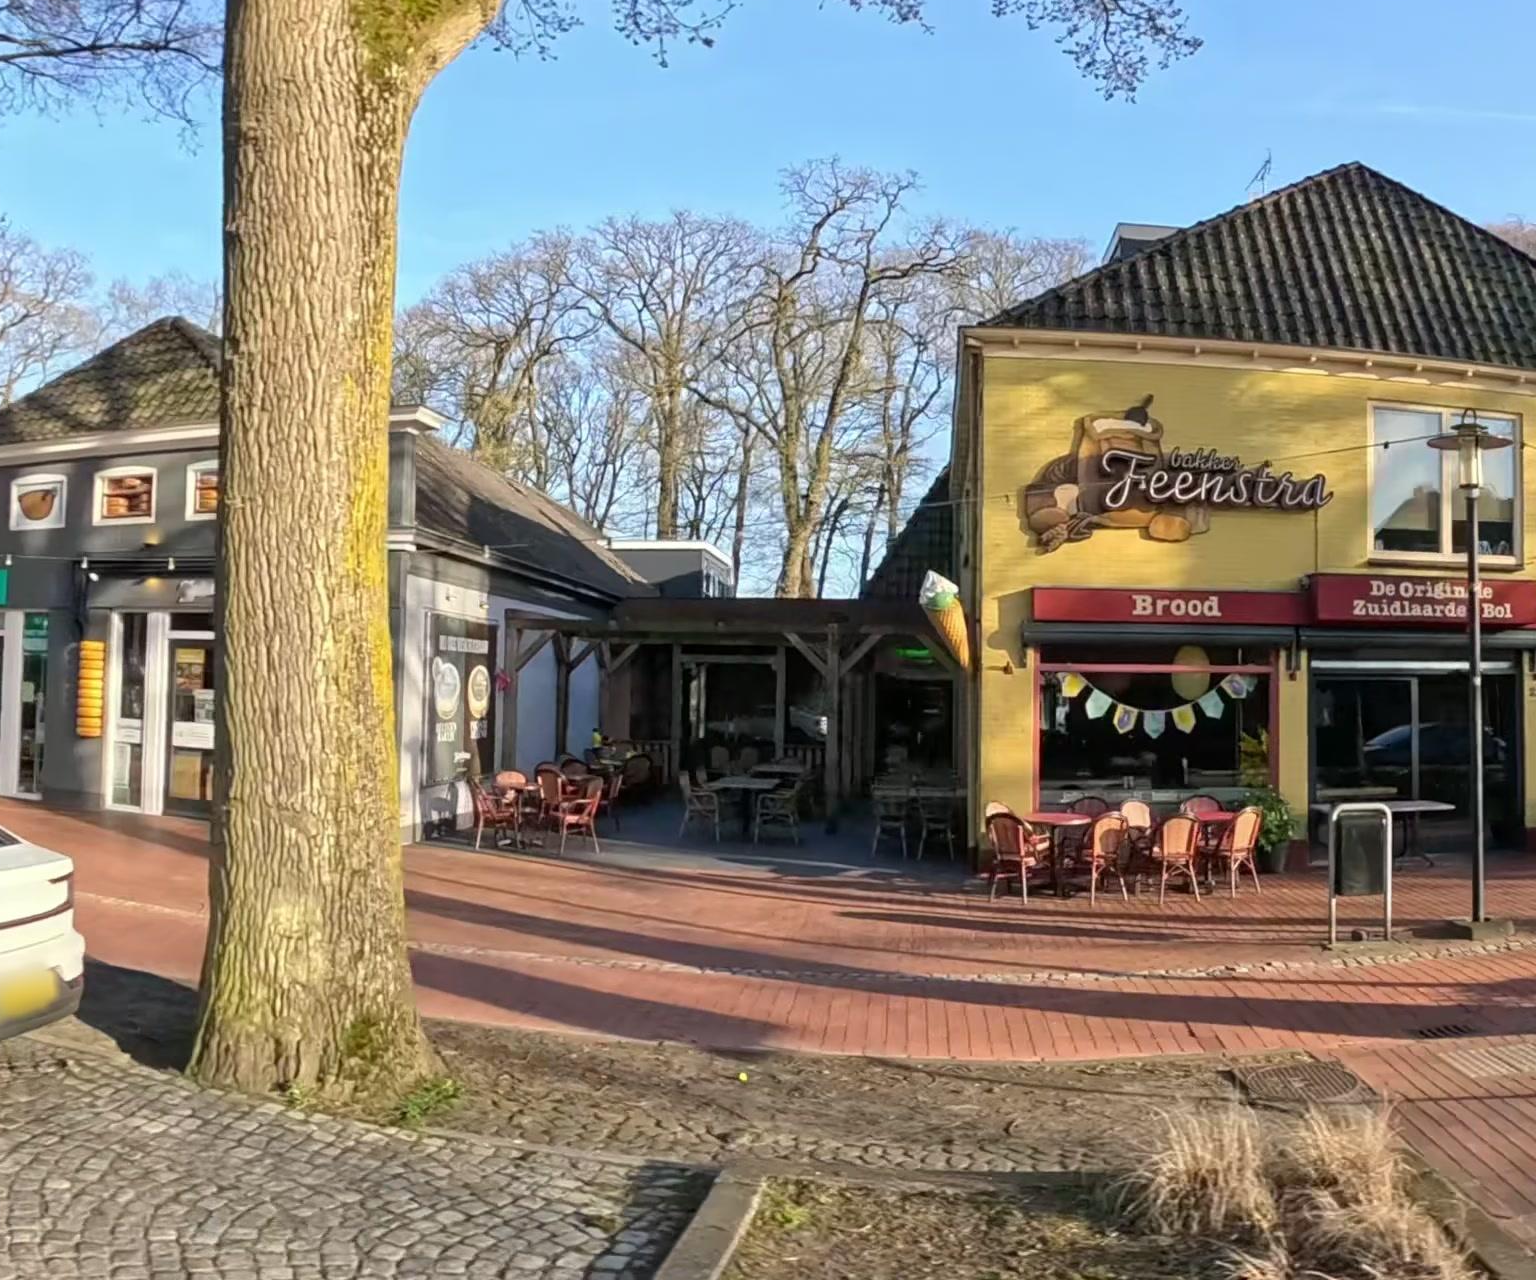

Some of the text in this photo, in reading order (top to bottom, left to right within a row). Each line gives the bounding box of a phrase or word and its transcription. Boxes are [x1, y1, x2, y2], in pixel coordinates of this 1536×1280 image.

[1170, 447, 1245, 471] bakker
[1101, 449, 1331, 508] Feenstra
[1370, 580, 1494, 599] De Originle
[1131, 594, 1222, 617] Brood
[1353, 600, 1513, 619] Zuidlaarde Bol
